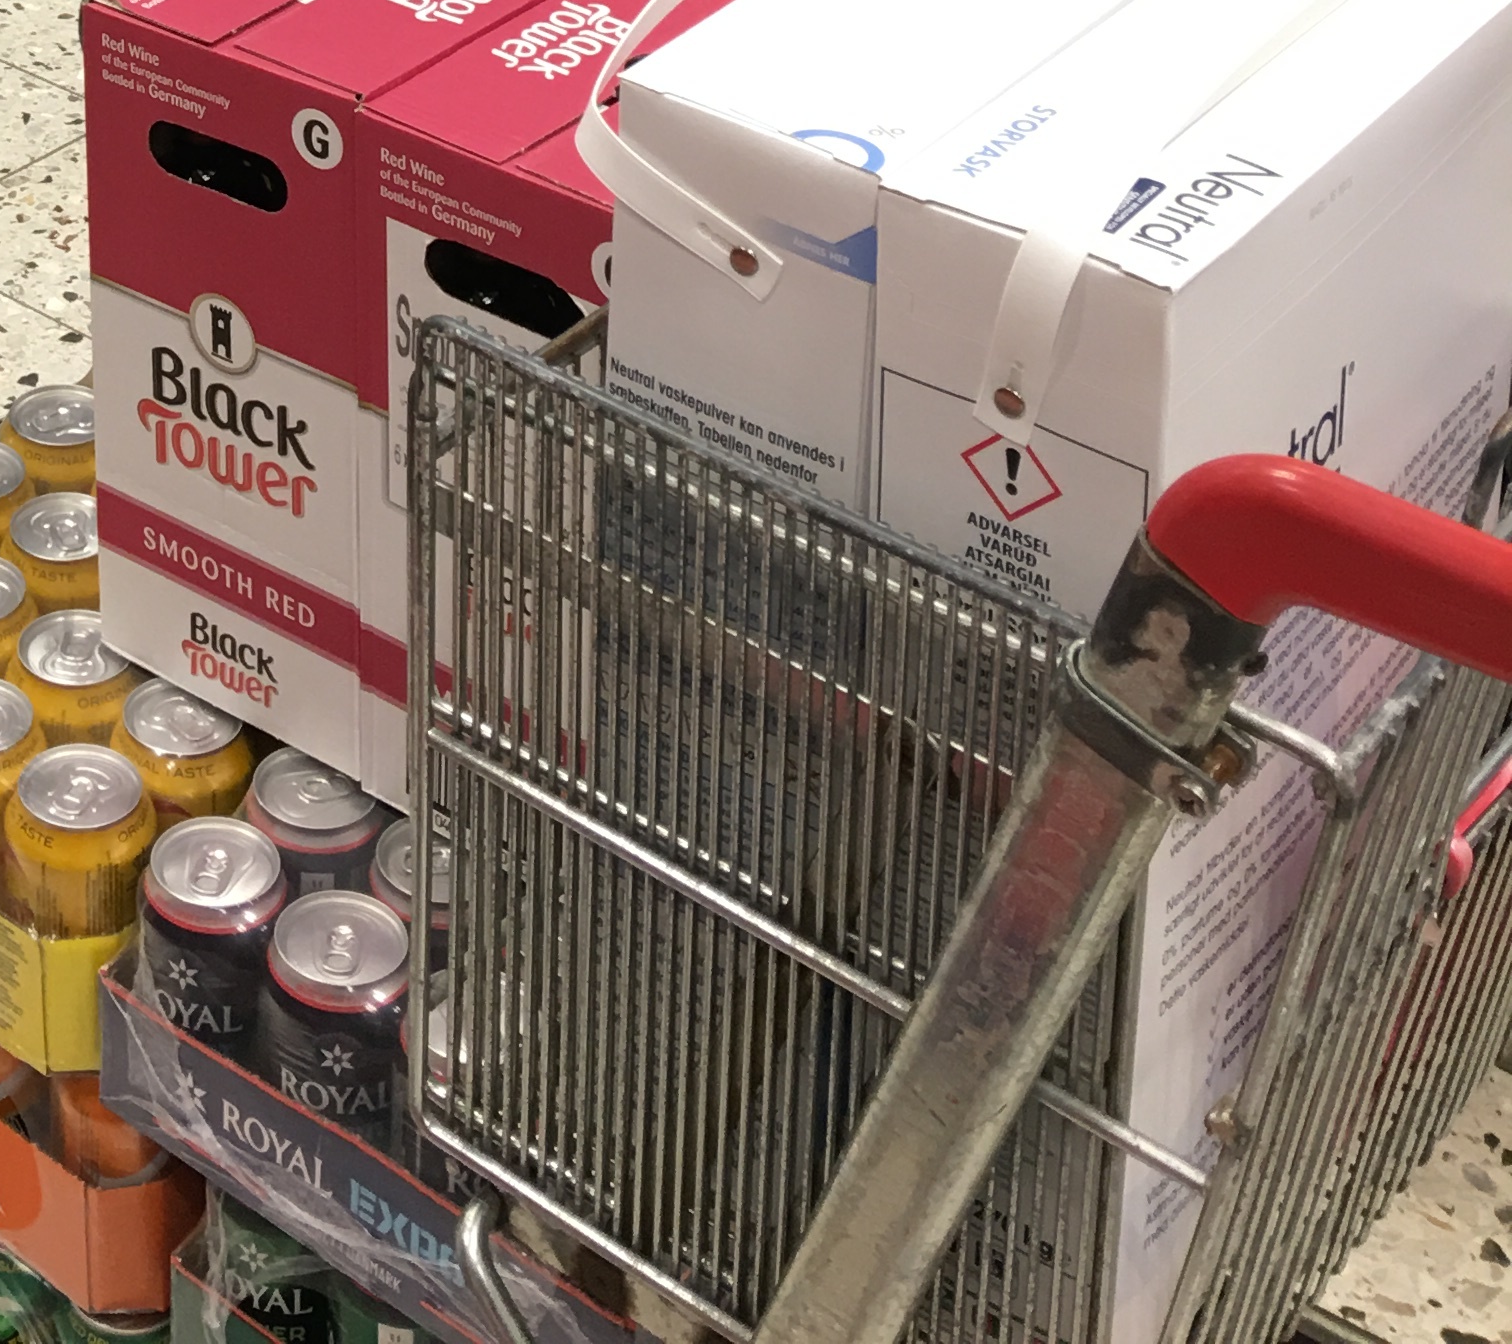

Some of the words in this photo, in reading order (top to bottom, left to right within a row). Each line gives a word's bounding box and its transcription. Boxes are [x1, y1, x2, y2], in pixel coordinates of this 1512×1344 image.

[102, 33, 125, 53] Red
[128, 42, 159, 67] Wine
[102, 53, 111, 64] of
[114, 57, 128, 70] the
[130, 61, 173, 88] European
[175, 79, 231, 109] Community
[102, 69, 134, 90] Bottled
[137, 79, 145, 93] in
[149, 84, 207, 119] Germany
[953, 104, 1057, 178] STORVASK
[1128, 153, 1284, 262] Neutral
[151, 346, 316, 471] Black
[610, 356, 656, 391] Neutral
[659, 380, 736, 426] vaskepulver
[740, 415, 764, 440] kan
[768, 430, 837, 468] anvendes
[137, 398, 318, 518] Tower
[697, 422, 753, 460] Tabellen
[756, 446, 818, 484] nedenfor
[965, 545, 1051, 592] ATSARGIAI
[967, 512, 1052, 558] ADVARSEL
[143, 526, 254, 600] SMOOTH
[265, 585, 316, 628] RED
[181, 639, 279, 708] Tower
[190, 612, 279, 684] Black
[279, 1067, 389, 1116] ROYAL
[222, 1098, 333, 1200] ROYAL
